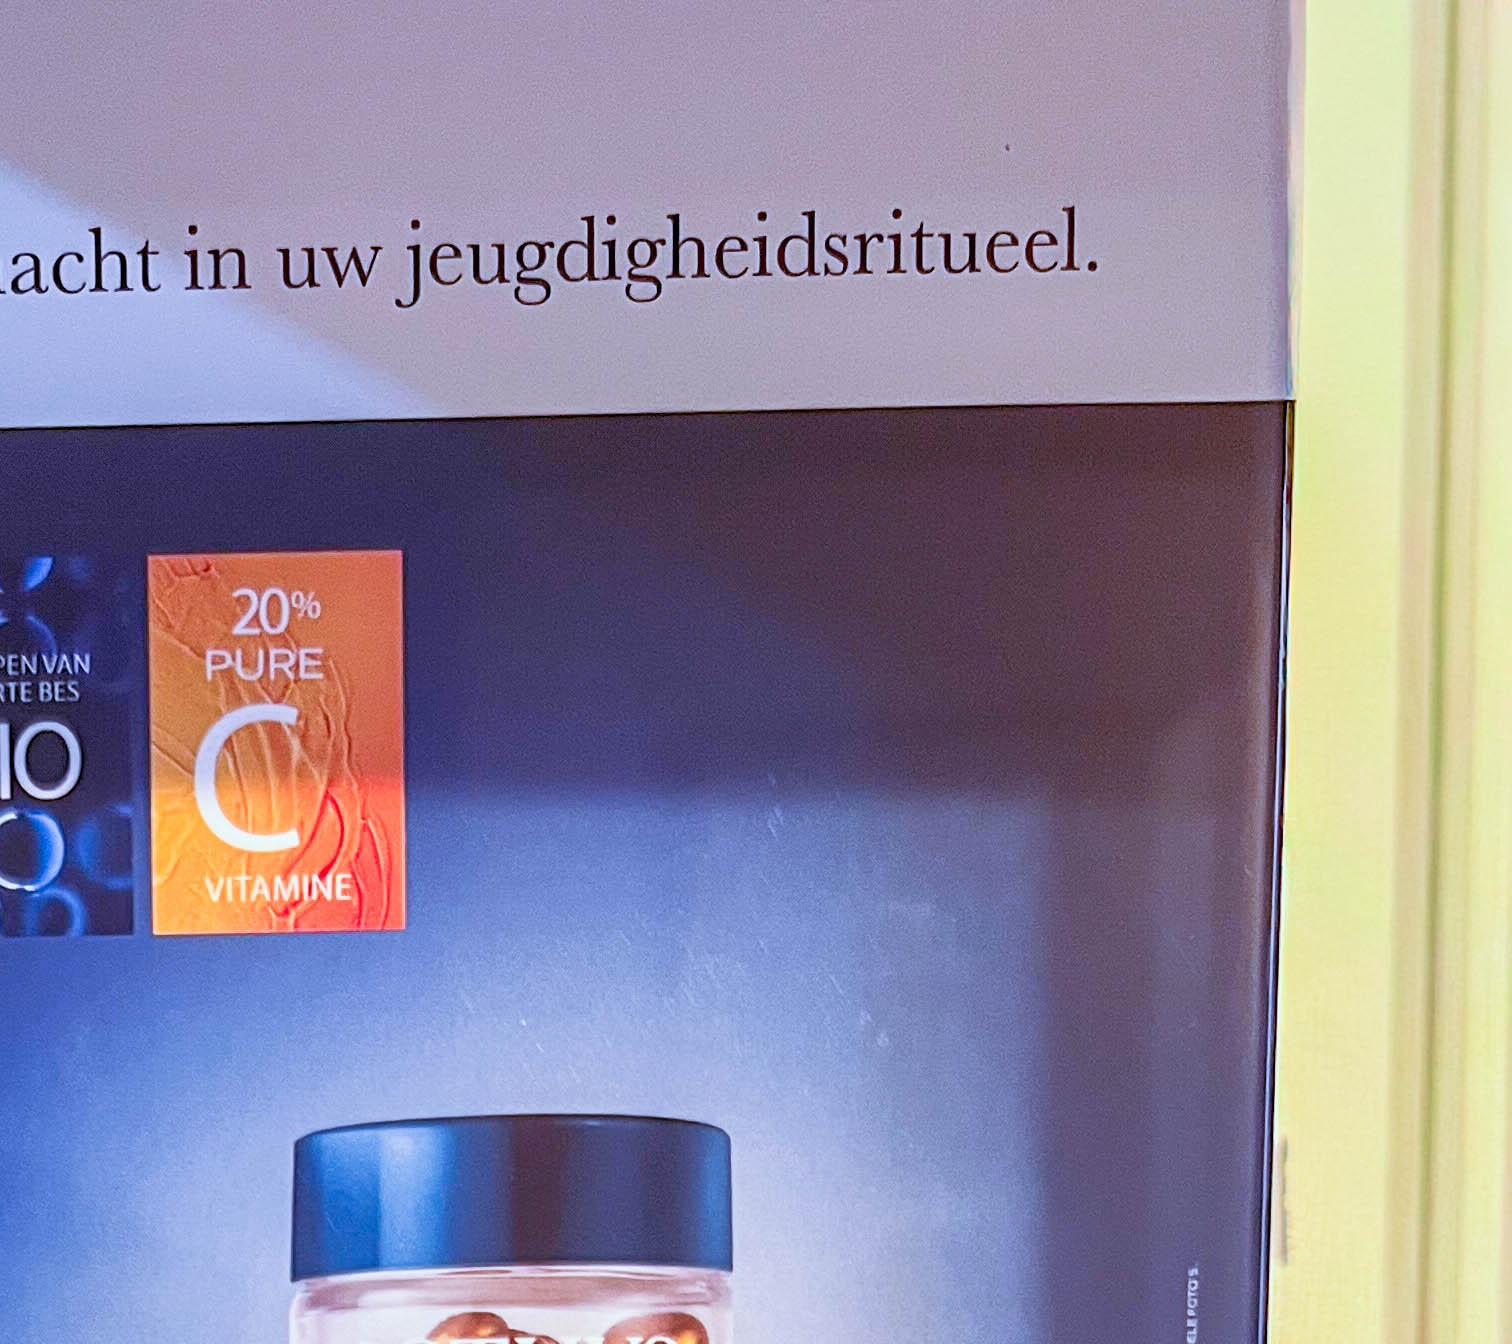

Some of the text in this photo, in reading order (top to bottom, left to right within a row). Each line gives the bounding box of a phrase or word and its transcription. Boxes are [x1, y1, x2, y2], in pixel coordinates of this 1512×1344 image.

[183, 223, 252, 294] in
[277, 233, 378, 292] uw
[395, 207, 1102, 308] jeugdigheidsritueel.
[231, 587, 321, 635] 20%
[41, 652, 90, 674] VAN
[204, 648, 324, 681] PURE
[35, 680, 79, 702] BES
[193, 703, 299, 853] C
[204, 872, 352, 905] VITAMINE
